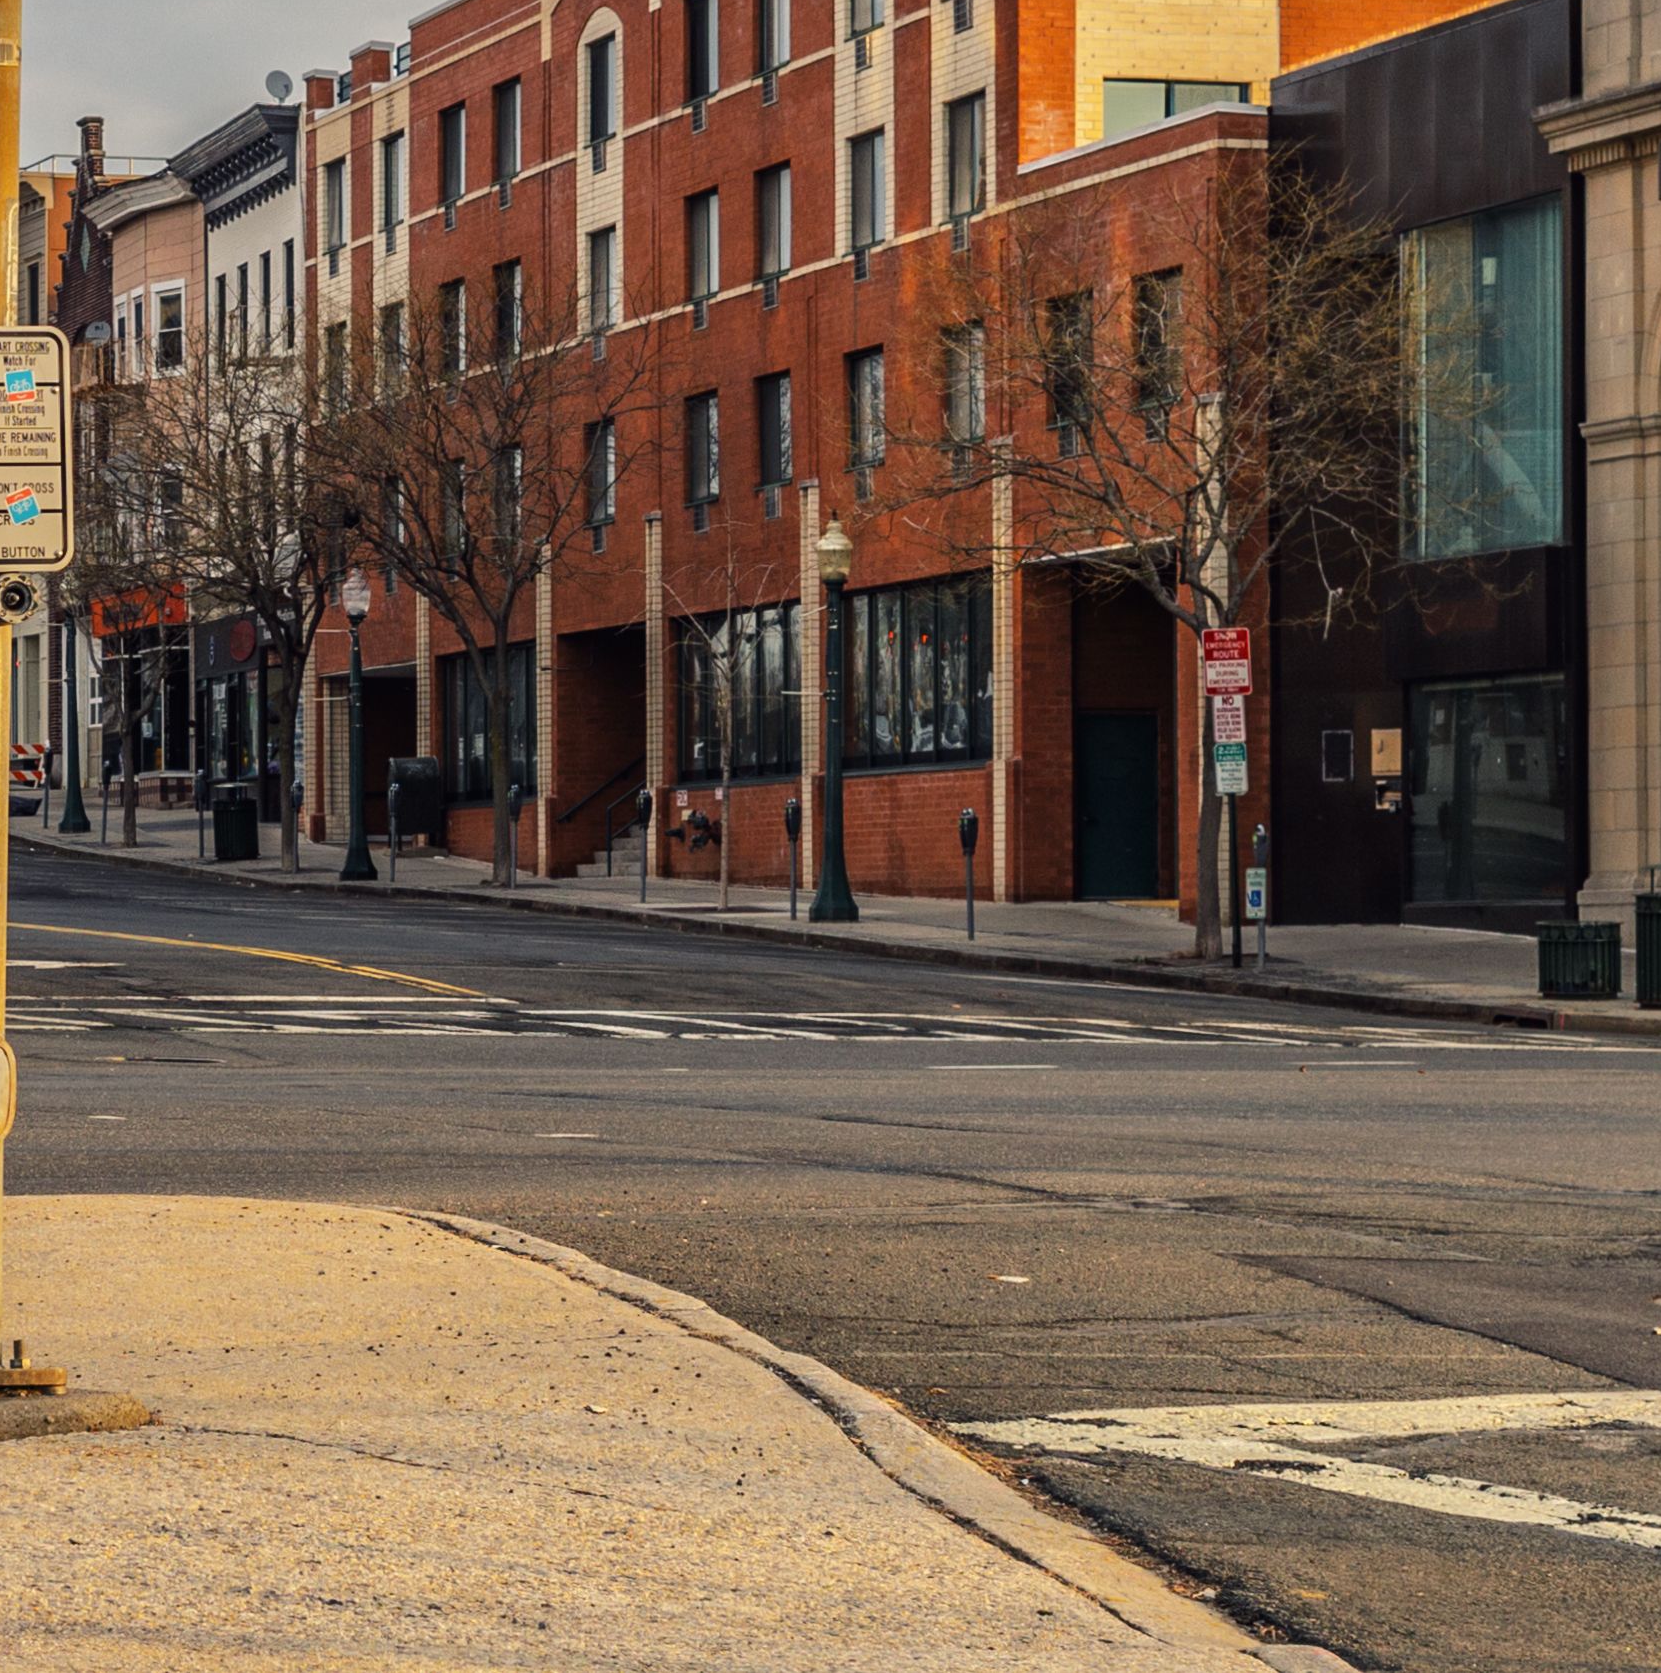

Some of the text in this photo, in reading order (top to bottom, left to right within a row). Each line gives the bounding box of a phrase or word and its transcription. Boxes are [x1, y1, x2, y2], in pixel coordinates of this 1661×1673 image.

[14, 341, 50, 353] CROSSING
[3, 355, 36, 366] Watch For
[17, 403, 45, 416] Crossing
[4, 415, 37, 426] If Started
[10, 432, 56, 444] REMAINING
[3, 446, 22, 457] Finish
[23, 446, 48, 459] Crossing
[1, 546, 46, 558] BUTTON
[1205, 640, 1246, 650] EMERGENCY
[1213, 649, 1239, 659] ROUTE
[1221, 696, 1234, 706] NO
